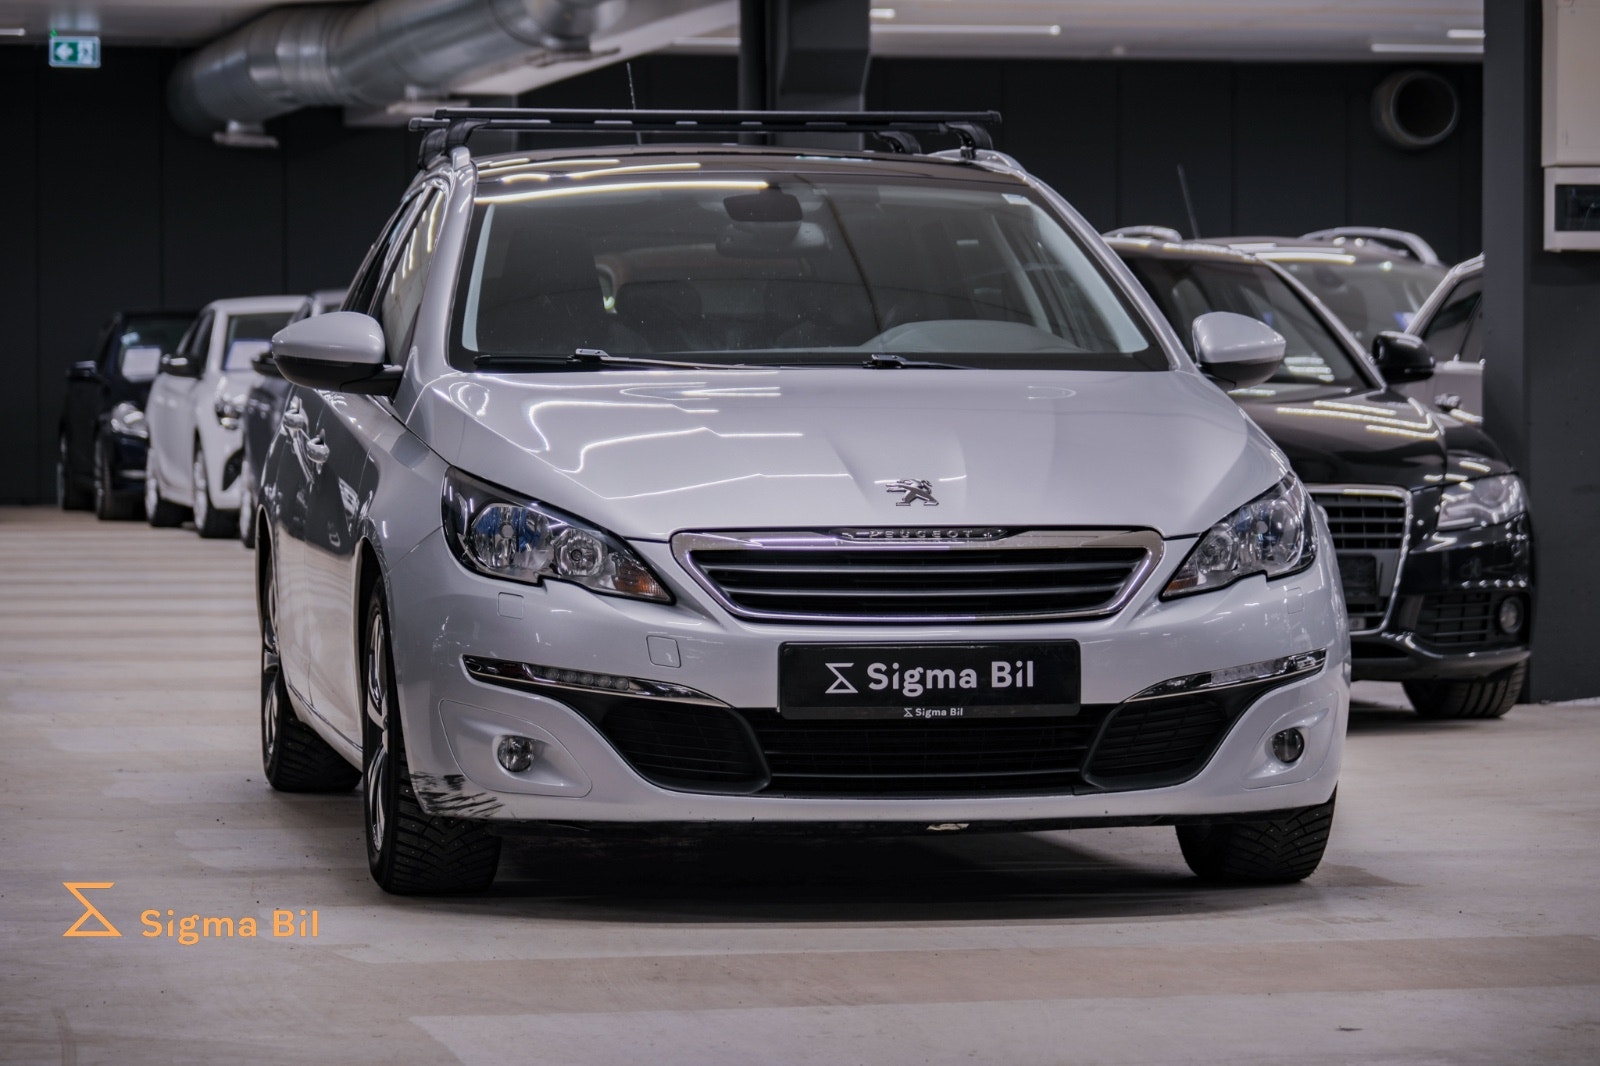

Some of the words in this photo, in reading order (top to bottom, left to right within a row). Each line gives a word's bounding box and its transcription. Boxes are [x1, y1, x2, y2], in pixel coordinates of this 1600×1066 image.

[868, 529, 974, 539] PEUGEOT
[866, 662, 978, 698] Sigma
[991, 660, 1034, 689] Bil
[915, 707, 947, 719] Sigma
[949, 707, 963, 716] Bil
